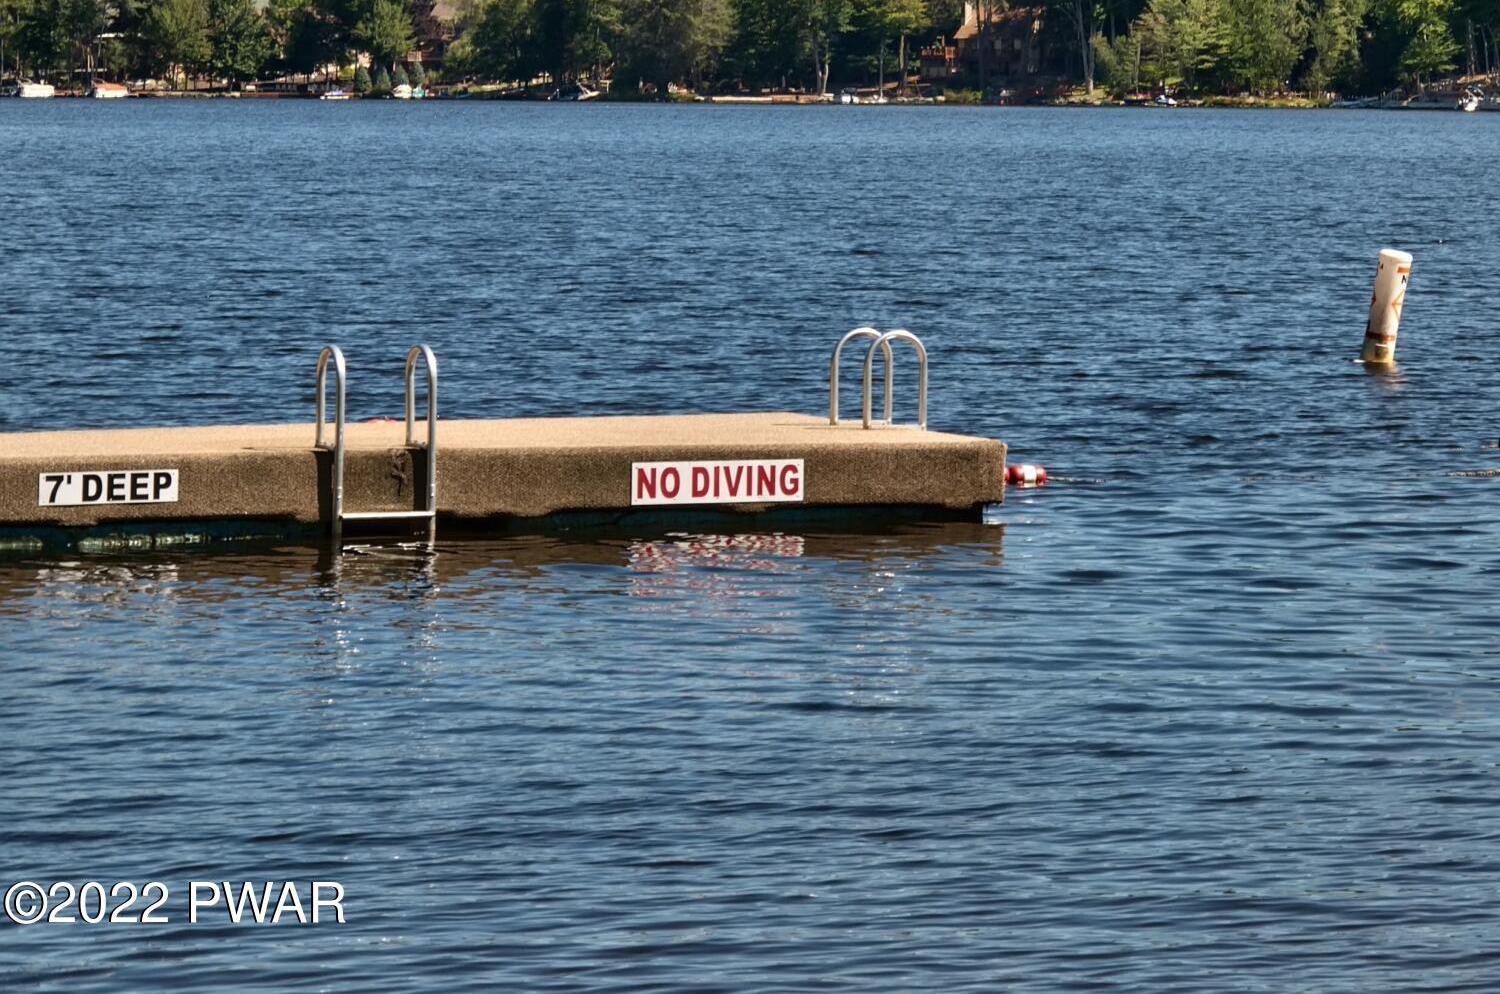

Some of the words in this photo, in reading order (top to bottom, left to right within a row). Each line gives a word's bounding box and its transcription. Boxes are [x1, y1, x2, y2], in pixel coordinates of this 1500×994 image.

[45, 475, 72, 503] 7'
[82, 472, 172, 502] DEEP
[637, 467, 680, 499] NO
[691, 464, 799, 498] DIVING
